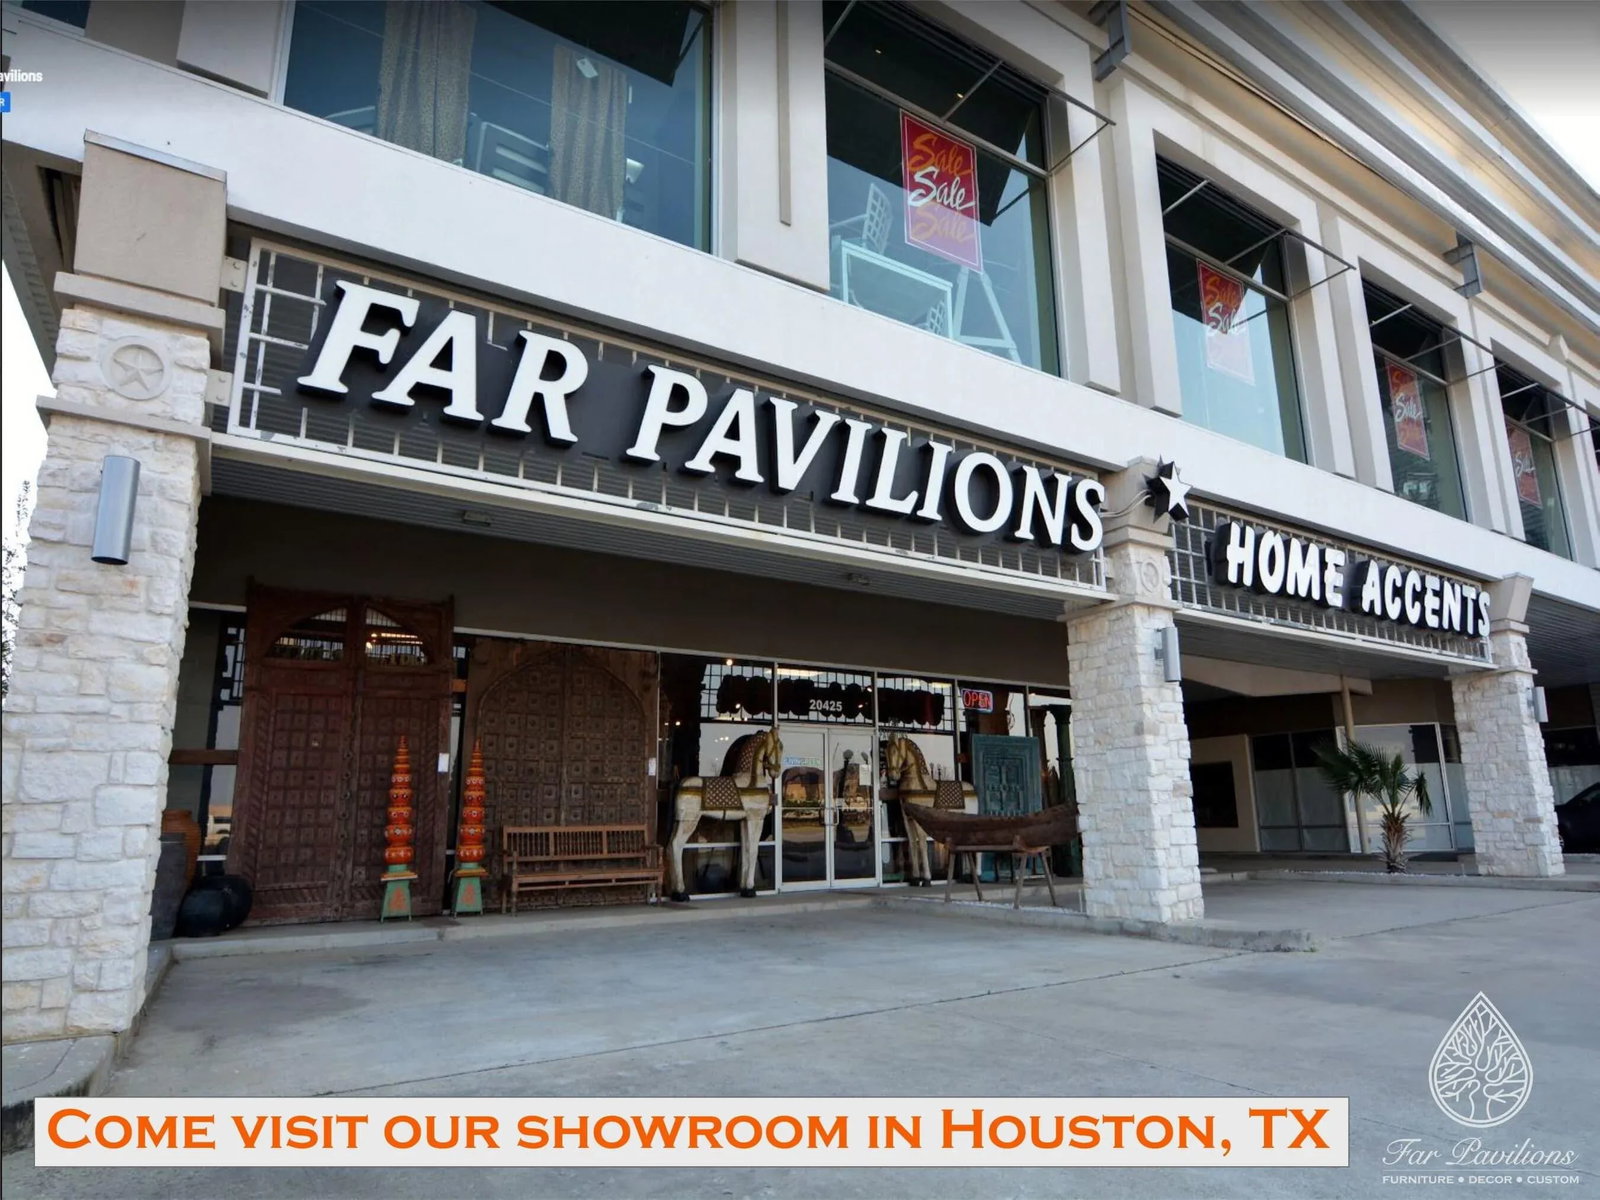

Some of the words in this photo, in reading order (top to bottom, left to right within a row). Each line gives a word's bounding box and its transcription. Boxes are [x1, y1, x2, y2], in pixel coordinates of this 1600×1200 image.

[908, 133, 973, 176] Sale
[908, 166, 976, 210] Sale
[298, 279, 588, 443] FAR
[626, 365, 1106, 552] PAVILIONS
[1226, 521, 1346, 608] HOME
[1361, 558, 1491, 638] ACCENTS
[809, 699, 843, 712] 20425
[963, 690, 992, 708] OPEN
